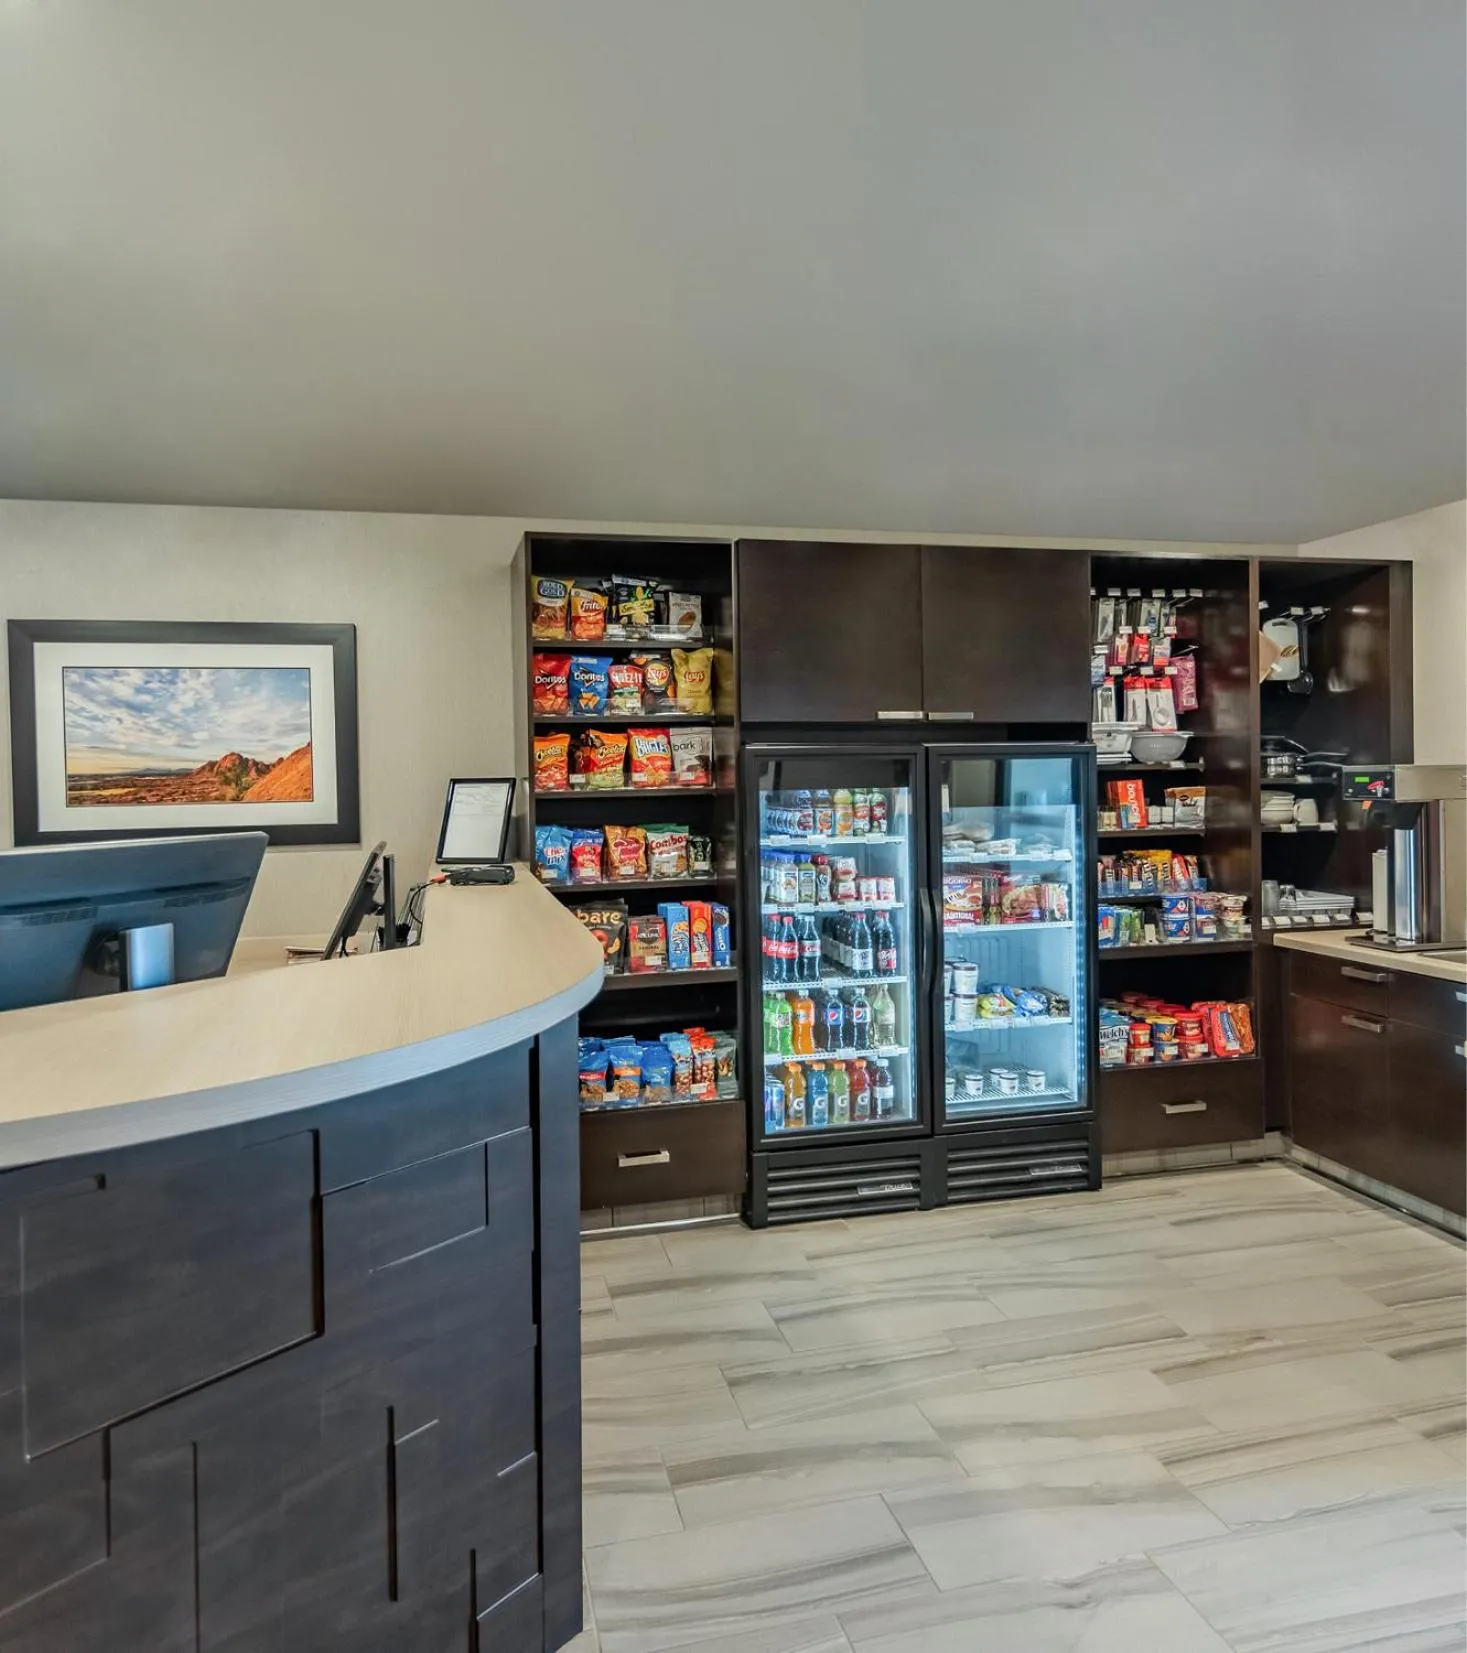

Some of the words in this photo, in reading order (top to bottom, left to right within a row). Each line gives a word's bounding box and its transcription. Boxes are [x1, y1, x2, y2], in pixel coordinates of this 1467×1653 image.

[535, 675, 567, 684] Doritos
[574, 671, 605, 682] Doritos
[684, 671, 705, 682] Lay's
[673, 741, 696, 751] bark
[650, 835, 688, 849] Combos
[576, 909, 621, 924] bare
